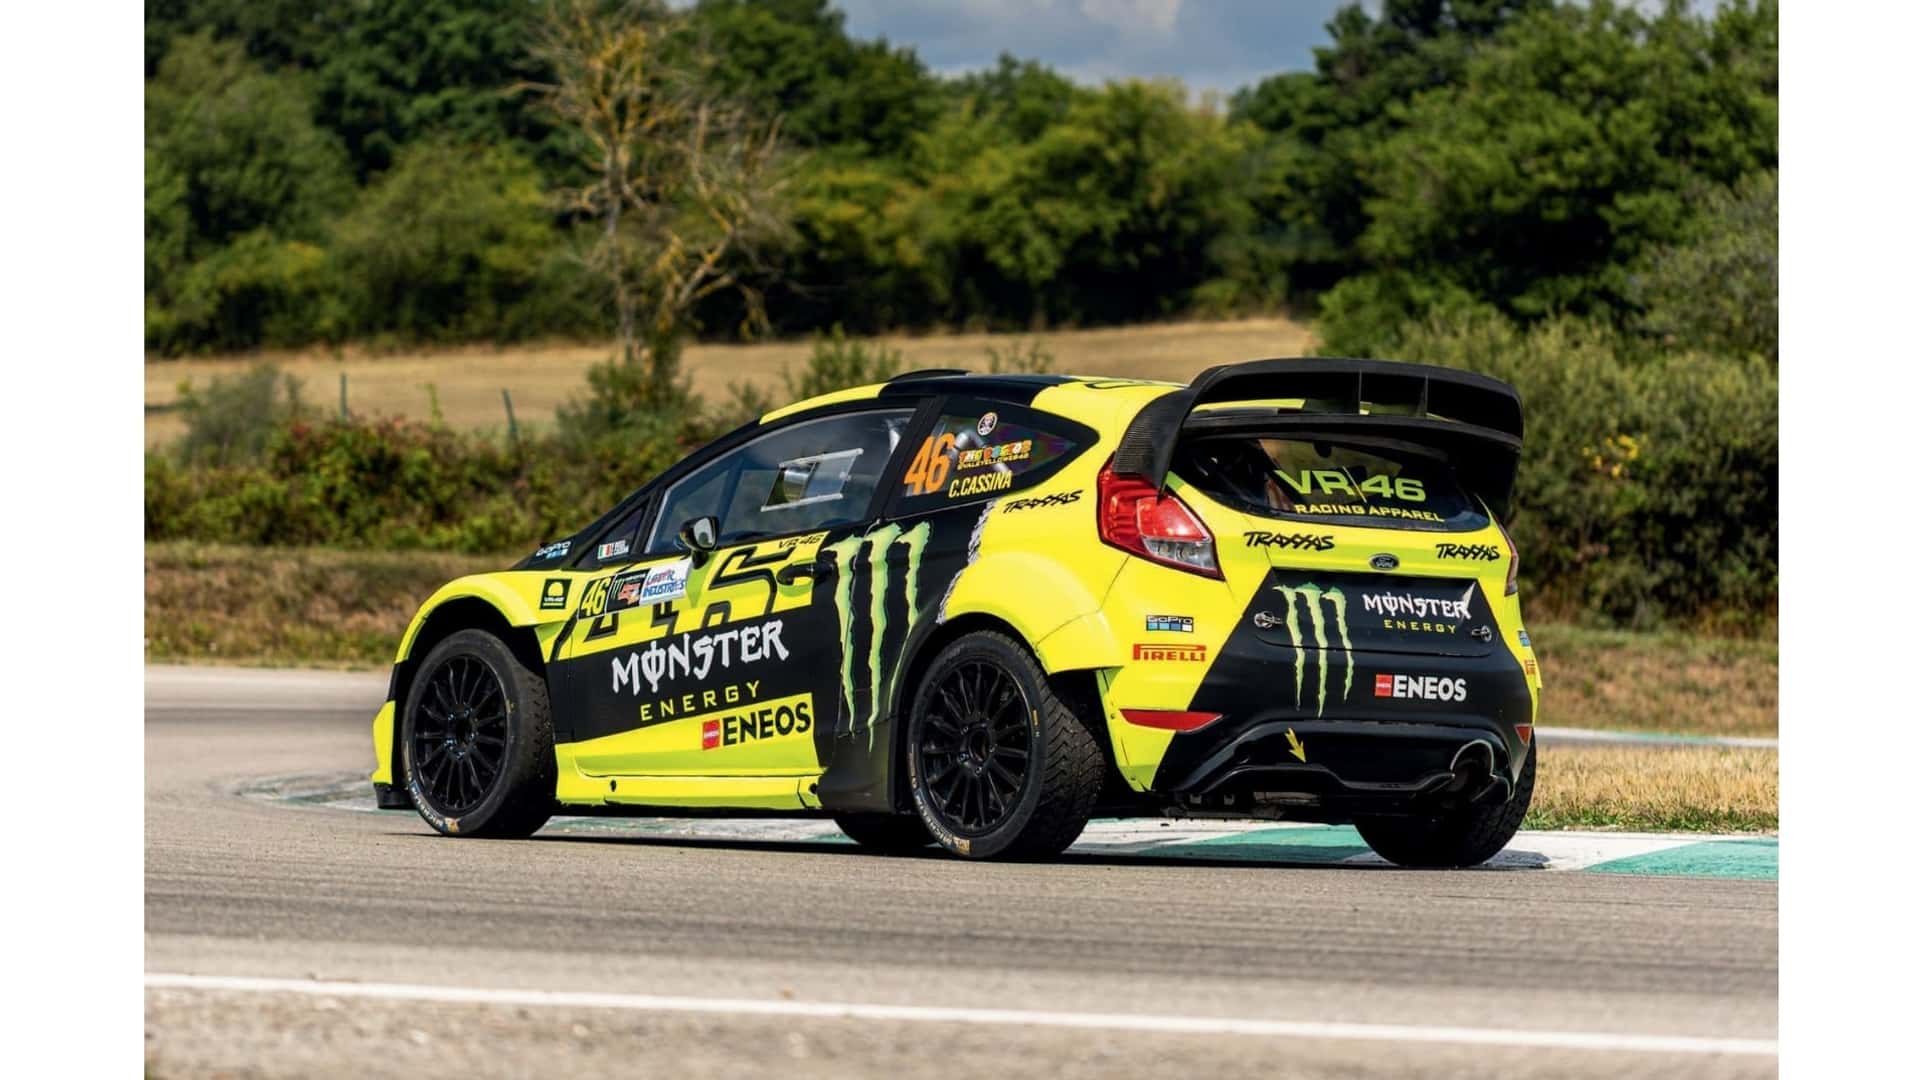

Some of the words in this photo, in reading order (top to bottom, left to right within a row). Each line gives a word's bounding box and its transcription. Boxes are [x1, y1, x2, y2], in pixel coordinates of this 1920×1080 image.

[904, 432, 957, 496] 46
[948, 470, 1013, 498] C.CASSINA
[1003, 489, 1084, 514] TRAXXAS
[1293, 504, 1366, 515] RACING
[1368, 505, 1445, 522] APPAREL
[1243, 531, 1335, 551] TRAXXAS
[1435, 543, 1500, 561] TRAXXAS
[581, 577, 611, 616] 46
[1147, 615, 1193, 625] GoPro
[1383, 619, 1457, 634] ENERGY
[1133, 643, 1206, 661] PIRELLI
[1393, 674, 1467, 701] ENEOS
[640, 680, 760, 721] ENERGY
[722, 702, 811, 746] ENEOS
